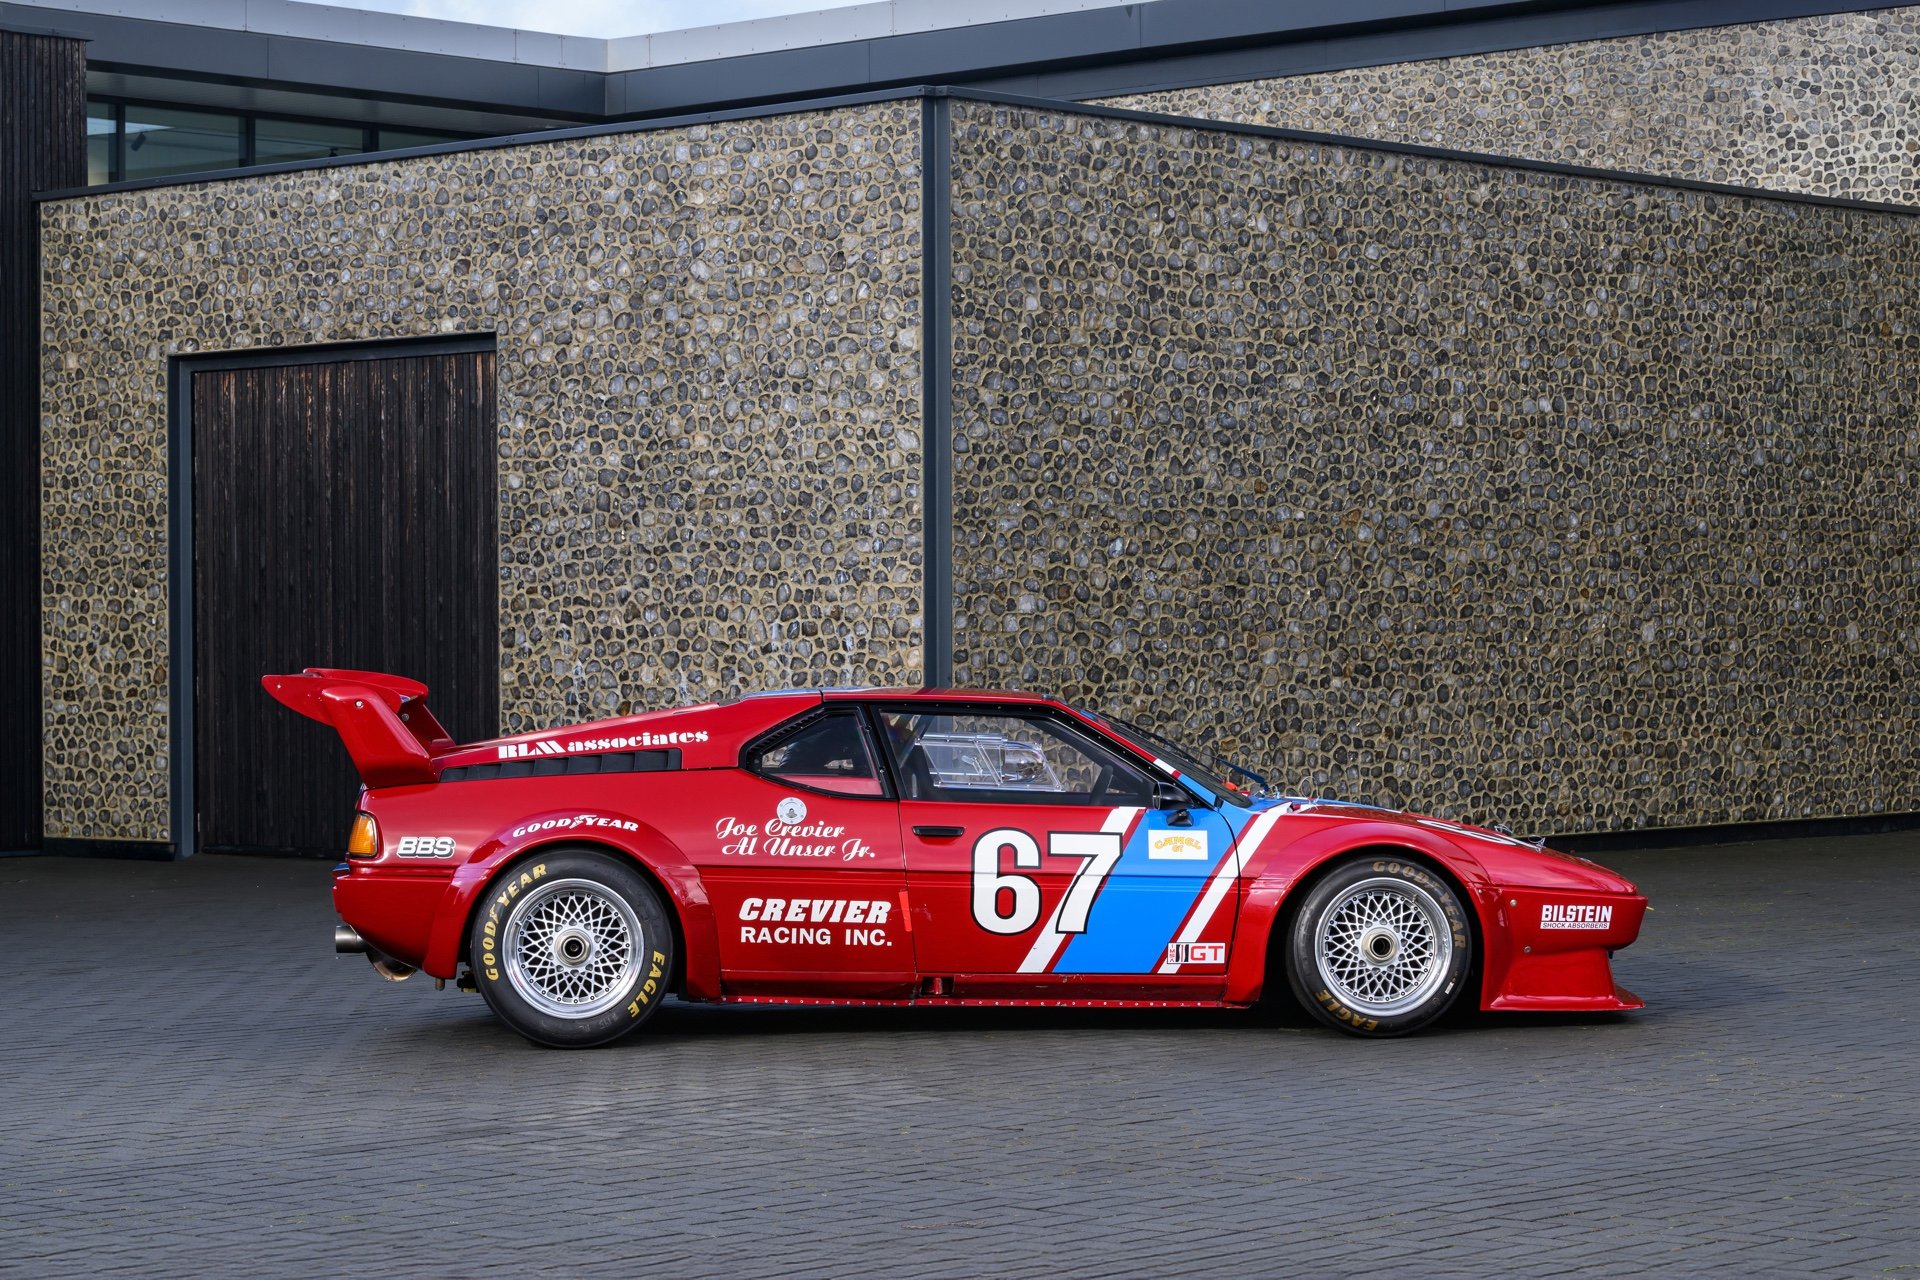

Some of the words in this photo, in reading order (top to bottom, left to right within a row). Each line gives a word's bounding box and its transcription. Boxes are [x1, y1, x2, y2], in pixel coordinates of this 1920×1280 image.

[567, 730, 709, 752] associates
[716, 817, 758, 839] Joe
[765, 818, 845, 838] Crevier
[397, 837, 456, 858] BBS
[721, 836, 758, 855] Al
[763, 837, 836, 857] Unser
[841, 838, 876, 861] Jr.
[1154, 836, 1202, 850] CAMEL
[970, 826, 1123, 936] 67
[738, 898, 892, 924] CREVIER
[1541, 904, 1613, 922] BILSTEIN
[740, 926, 831, 945] RACING
[845, 928, 893, 947] INC.
[1190, 945, 1224, 961] GT
[627, 950, 666, 1018] EAGLE
[1315, 989, 1380, 1031] EAGLE
